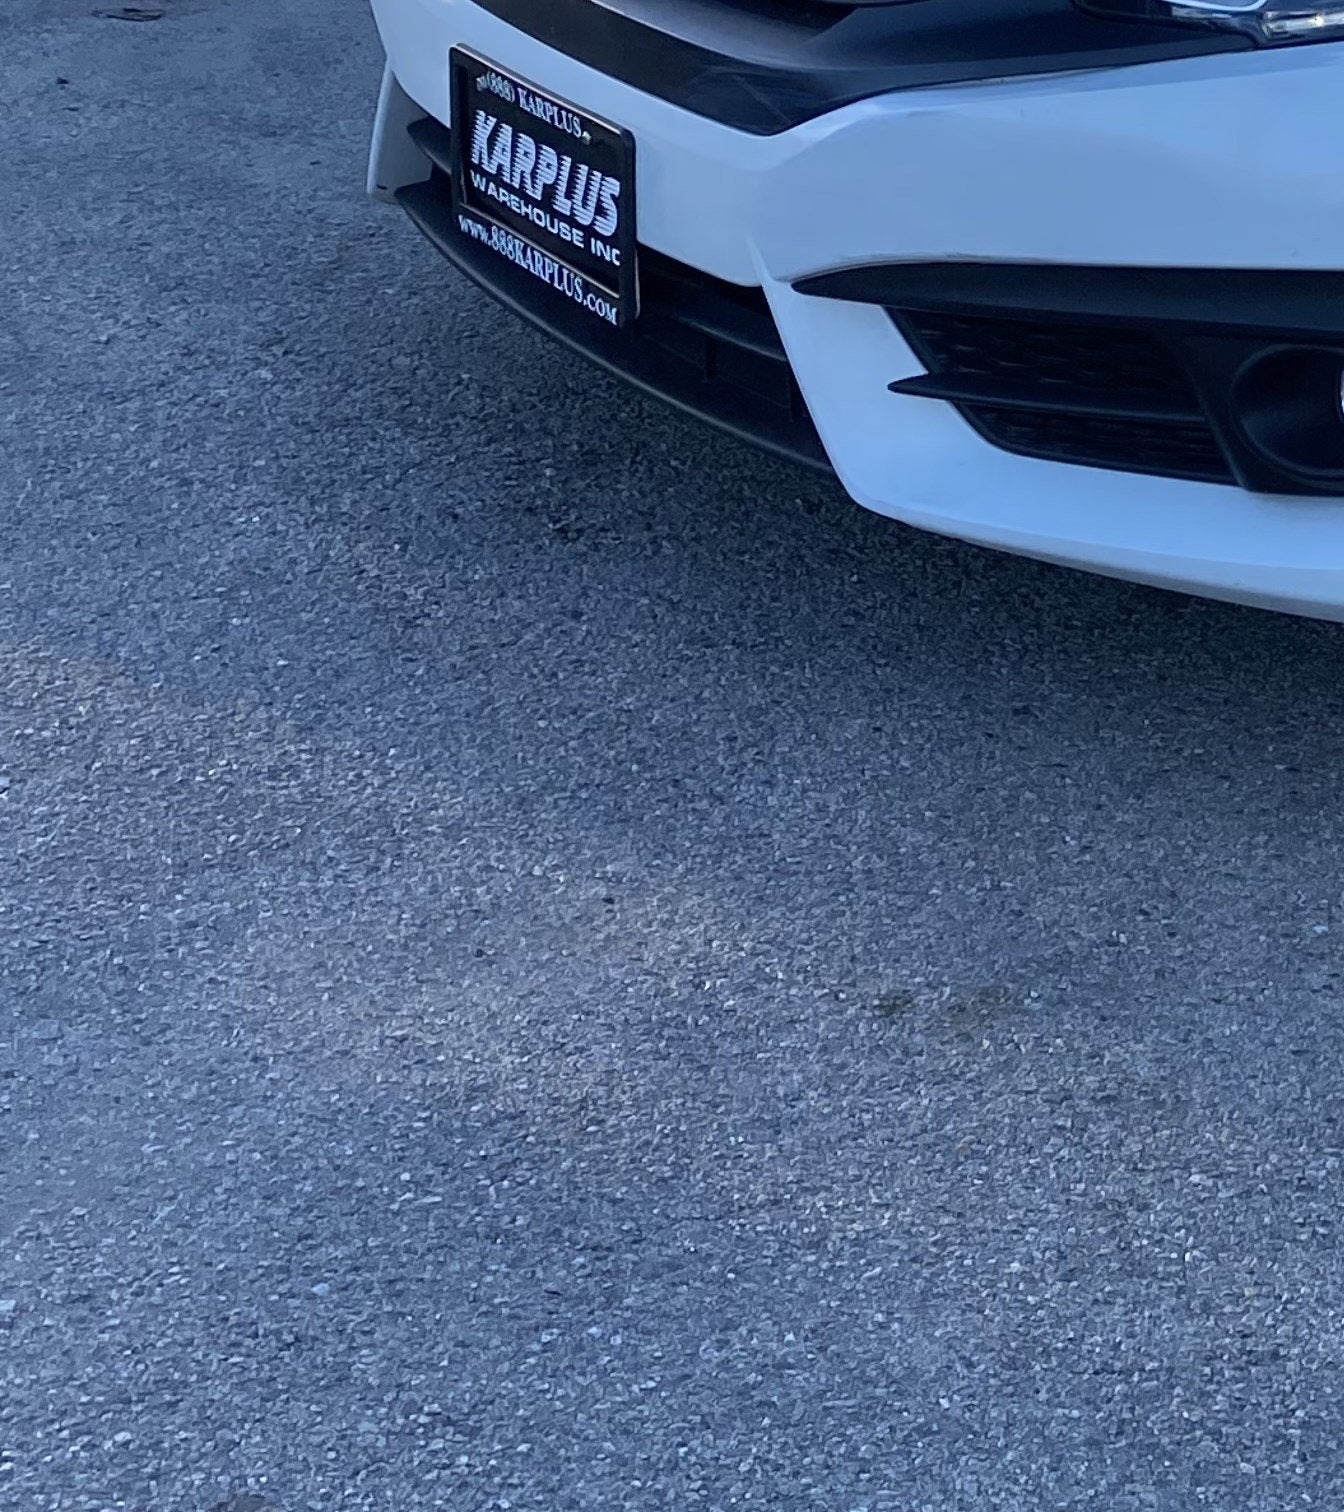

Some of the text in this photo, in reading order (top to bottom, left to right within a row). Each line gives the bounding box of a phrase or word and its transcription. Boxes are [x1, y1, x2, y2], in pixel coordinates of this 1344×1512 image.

[517, 87, 581, 138] KARPLUS
[470, 109, 620, 237] KARPLUS
[470, 170, 621, 266] WAREHOUSE INC
